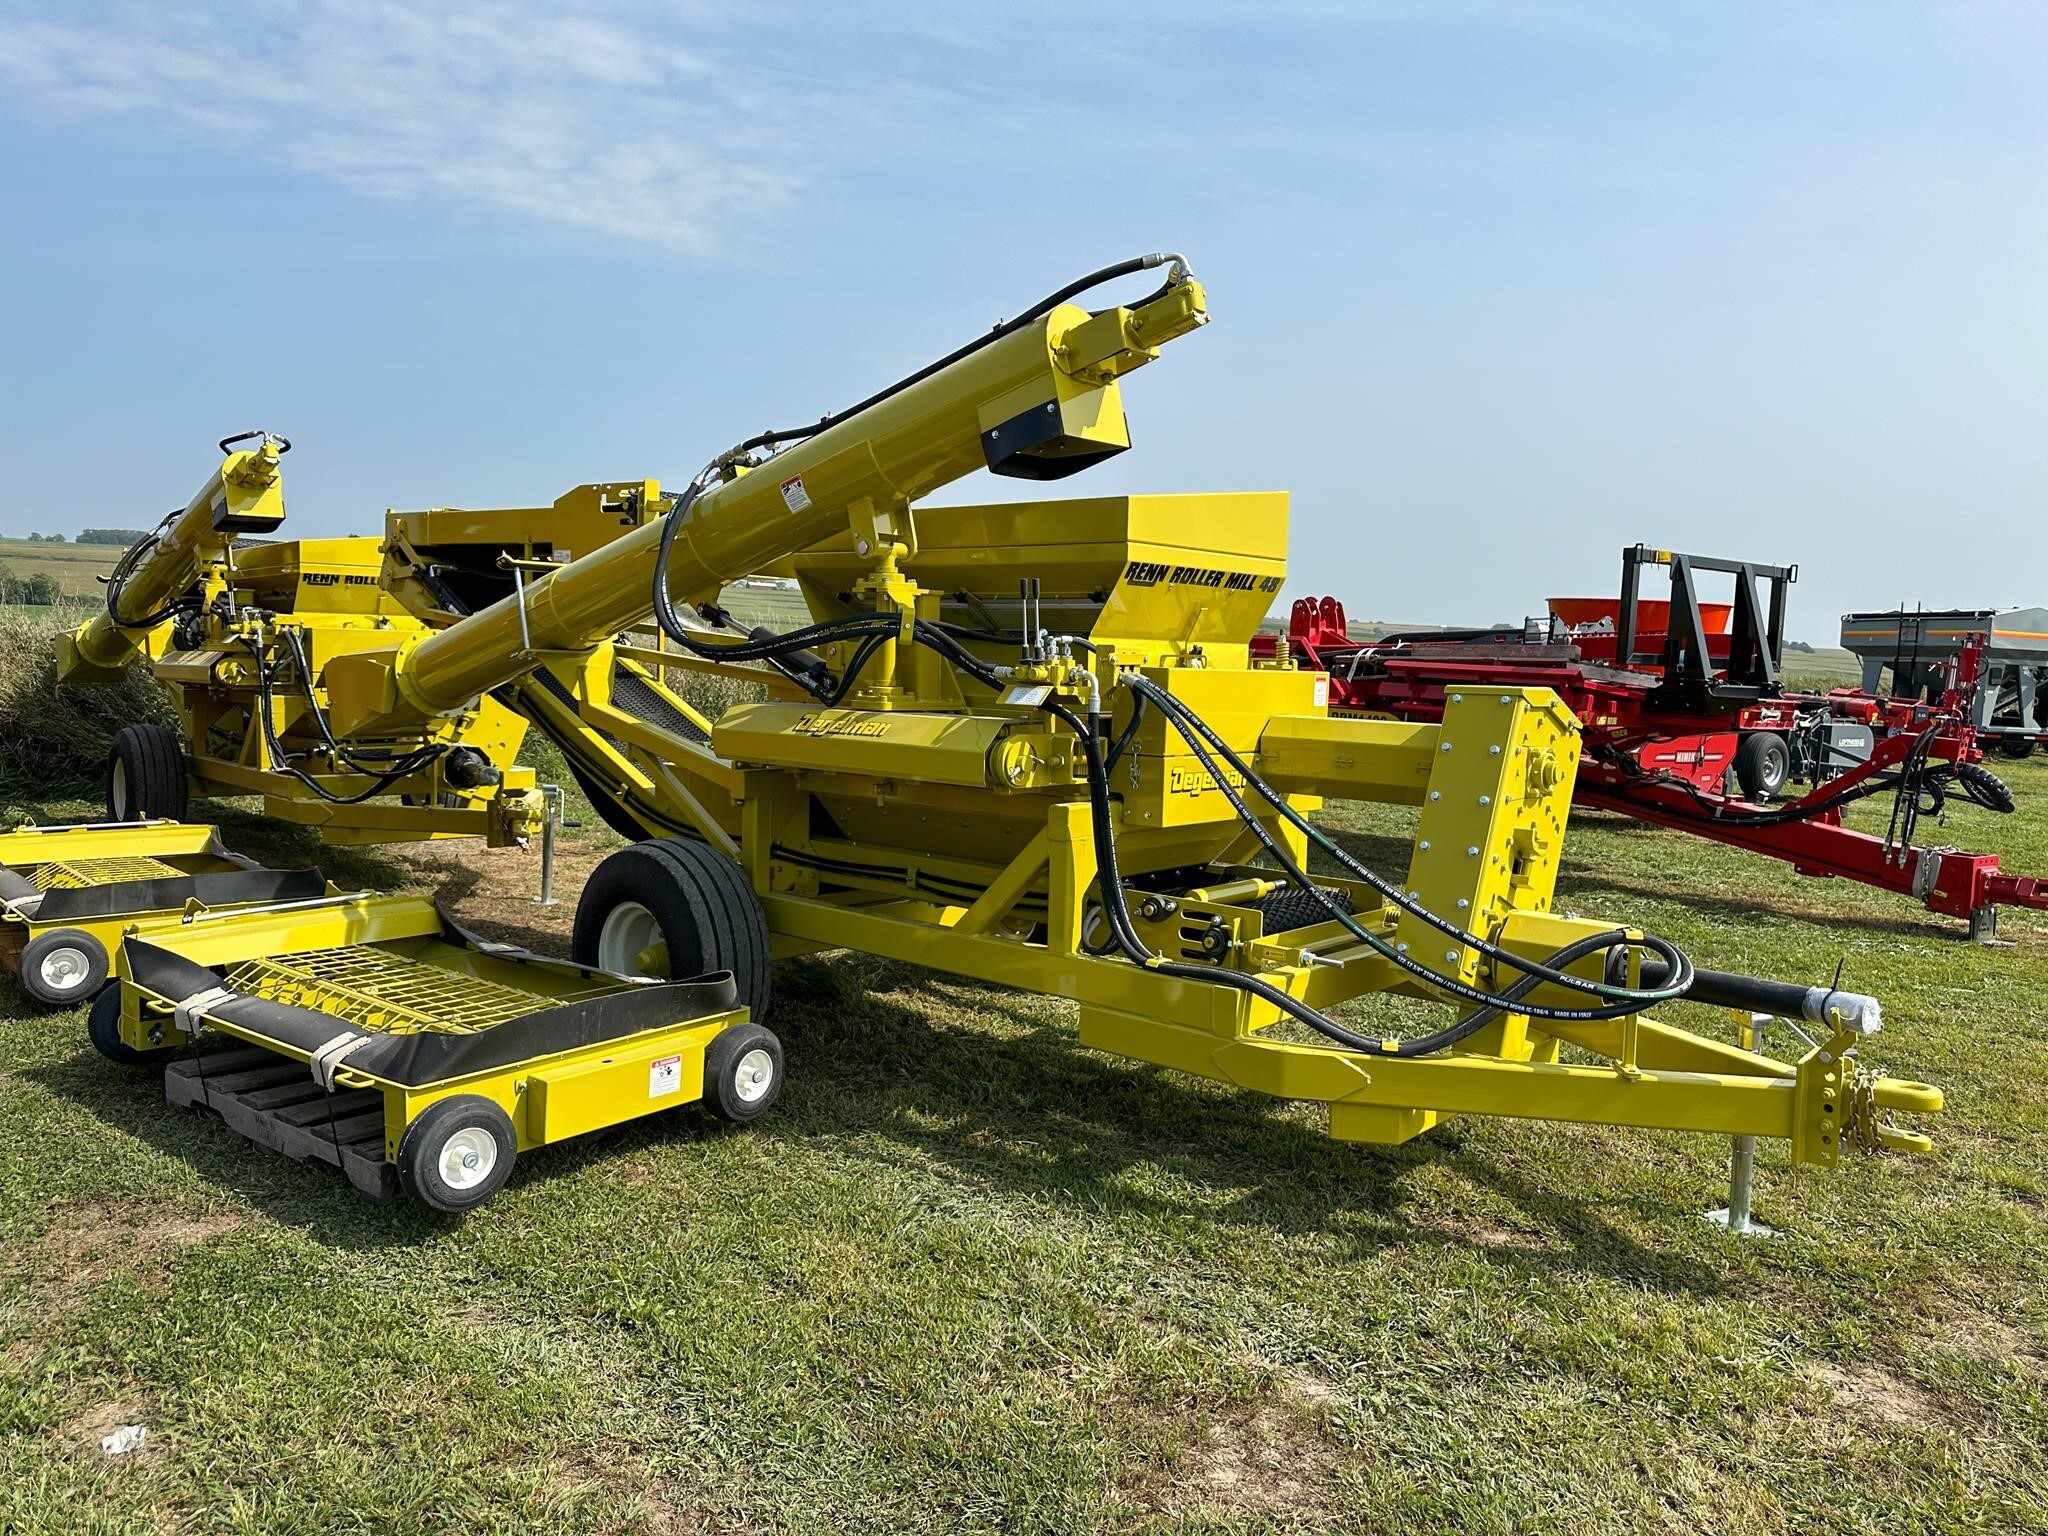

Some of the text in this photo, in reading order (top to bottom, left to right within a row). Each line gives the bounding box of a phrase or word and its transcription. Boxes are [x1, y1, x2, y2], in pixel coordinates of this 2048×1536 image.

[302, 573, 340, 586] RENN
[1124, 562, 1280, 593] RENN ROLLER MILL 48
[792, 712, 892, 737] Degelman
[1676, 751, 1696, 762] HINIK
[1560, 975, 1595, 990] PULSAR
[1554, 1010, 1571, 1018] MADE
[1571, 1010, 1578, 1018] IN
[1578, 1010, 1592, 1018] ITALY
